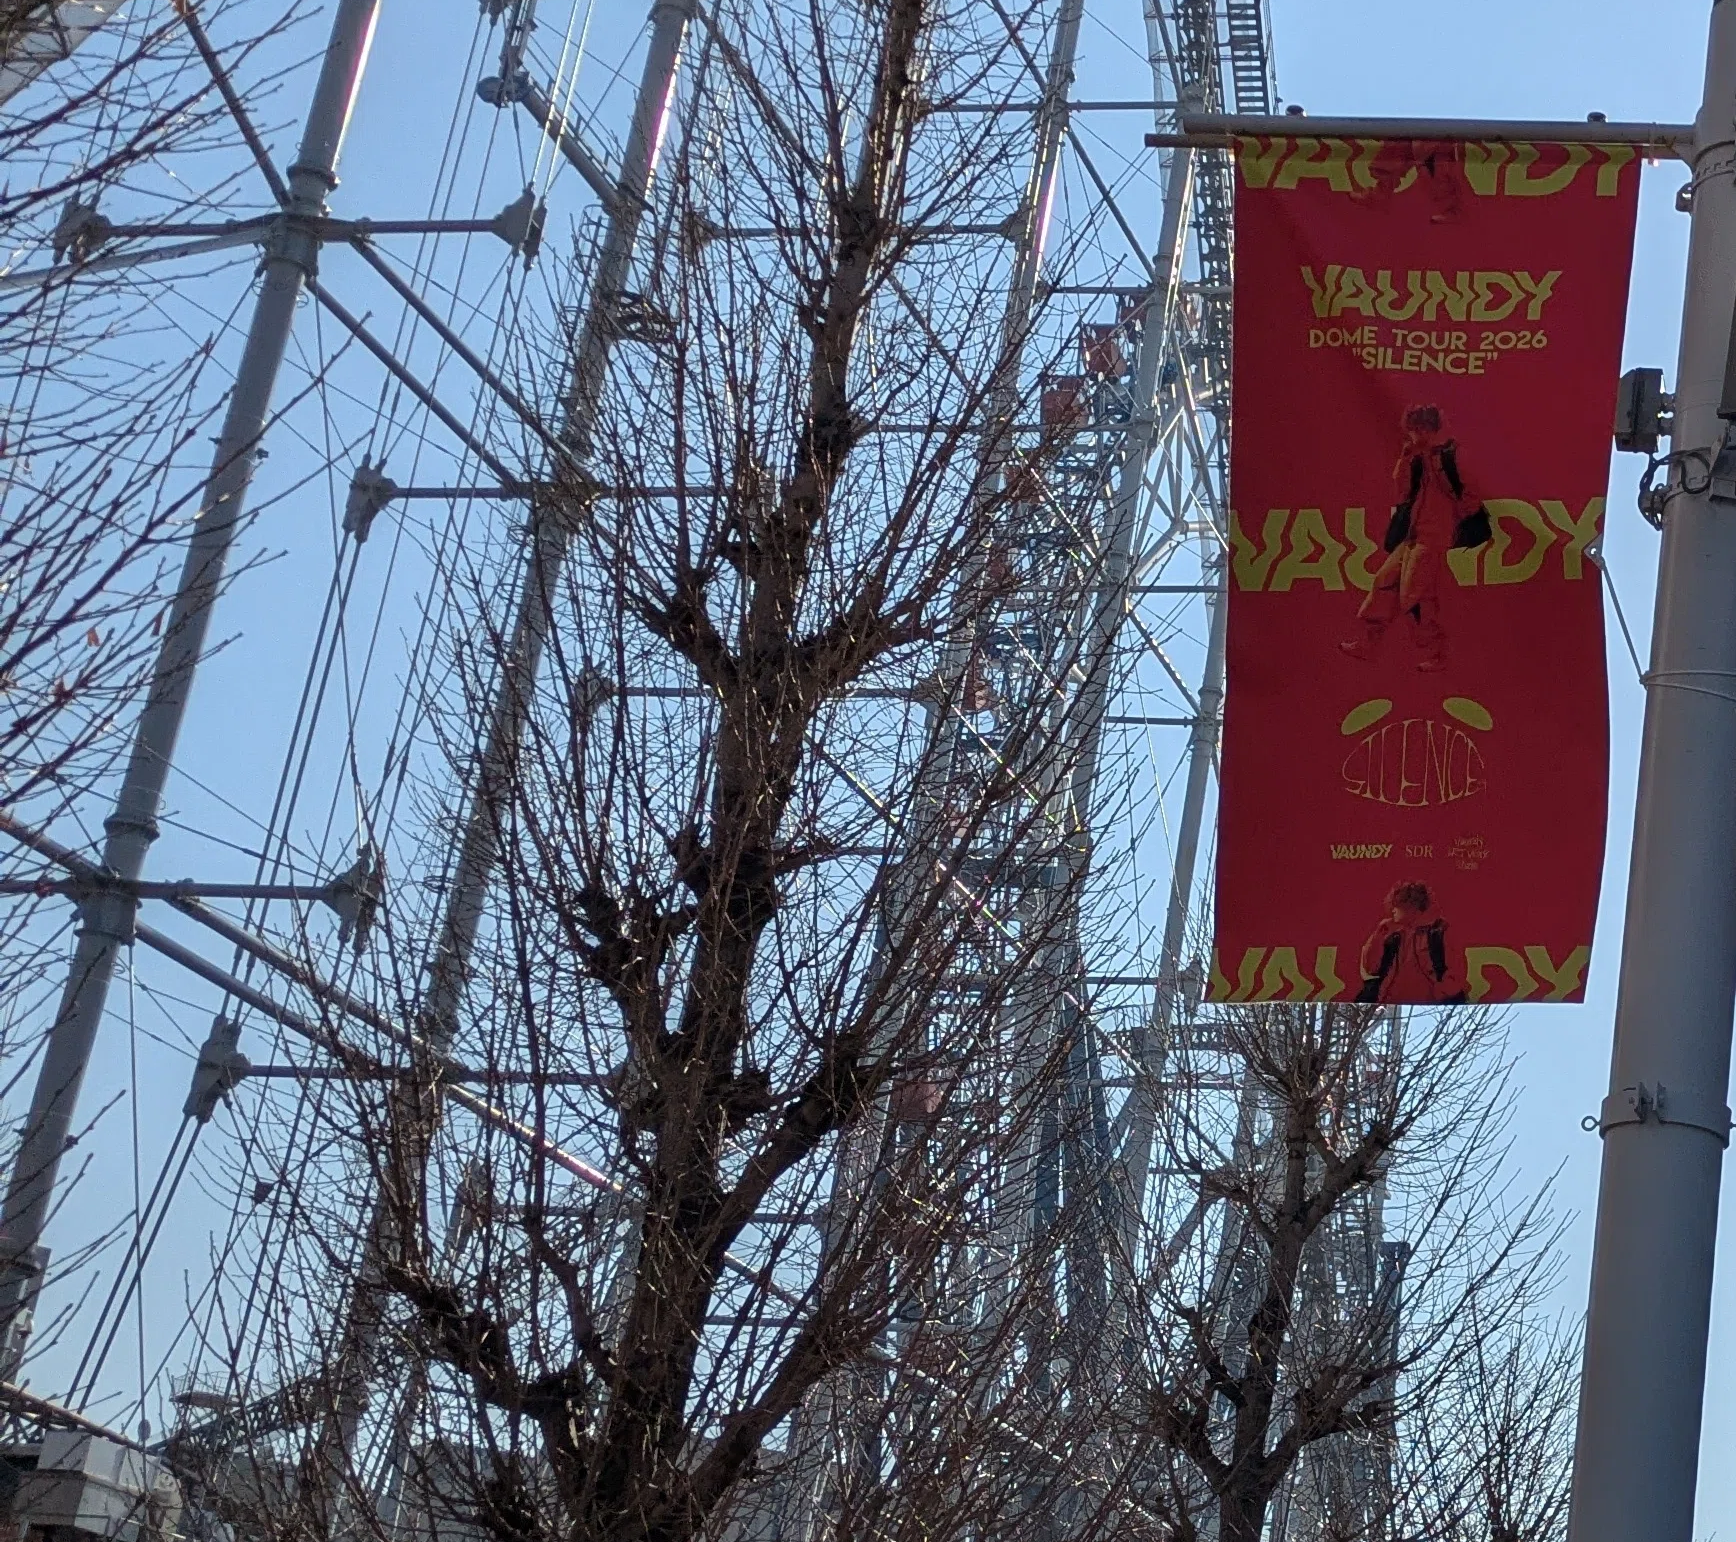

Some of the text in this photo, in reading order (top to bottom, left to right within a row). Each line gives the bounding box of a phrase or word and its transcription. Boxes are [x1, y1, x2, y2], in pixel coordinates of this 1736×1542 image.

[1301, 265, 1563, 321] VAUNDY
[1309, 326, 1548, 350] DOME TOUR 2026
[1330, 844, 1393, 860] VAUNDY
[1405, 845, 1434, 858] SDR
